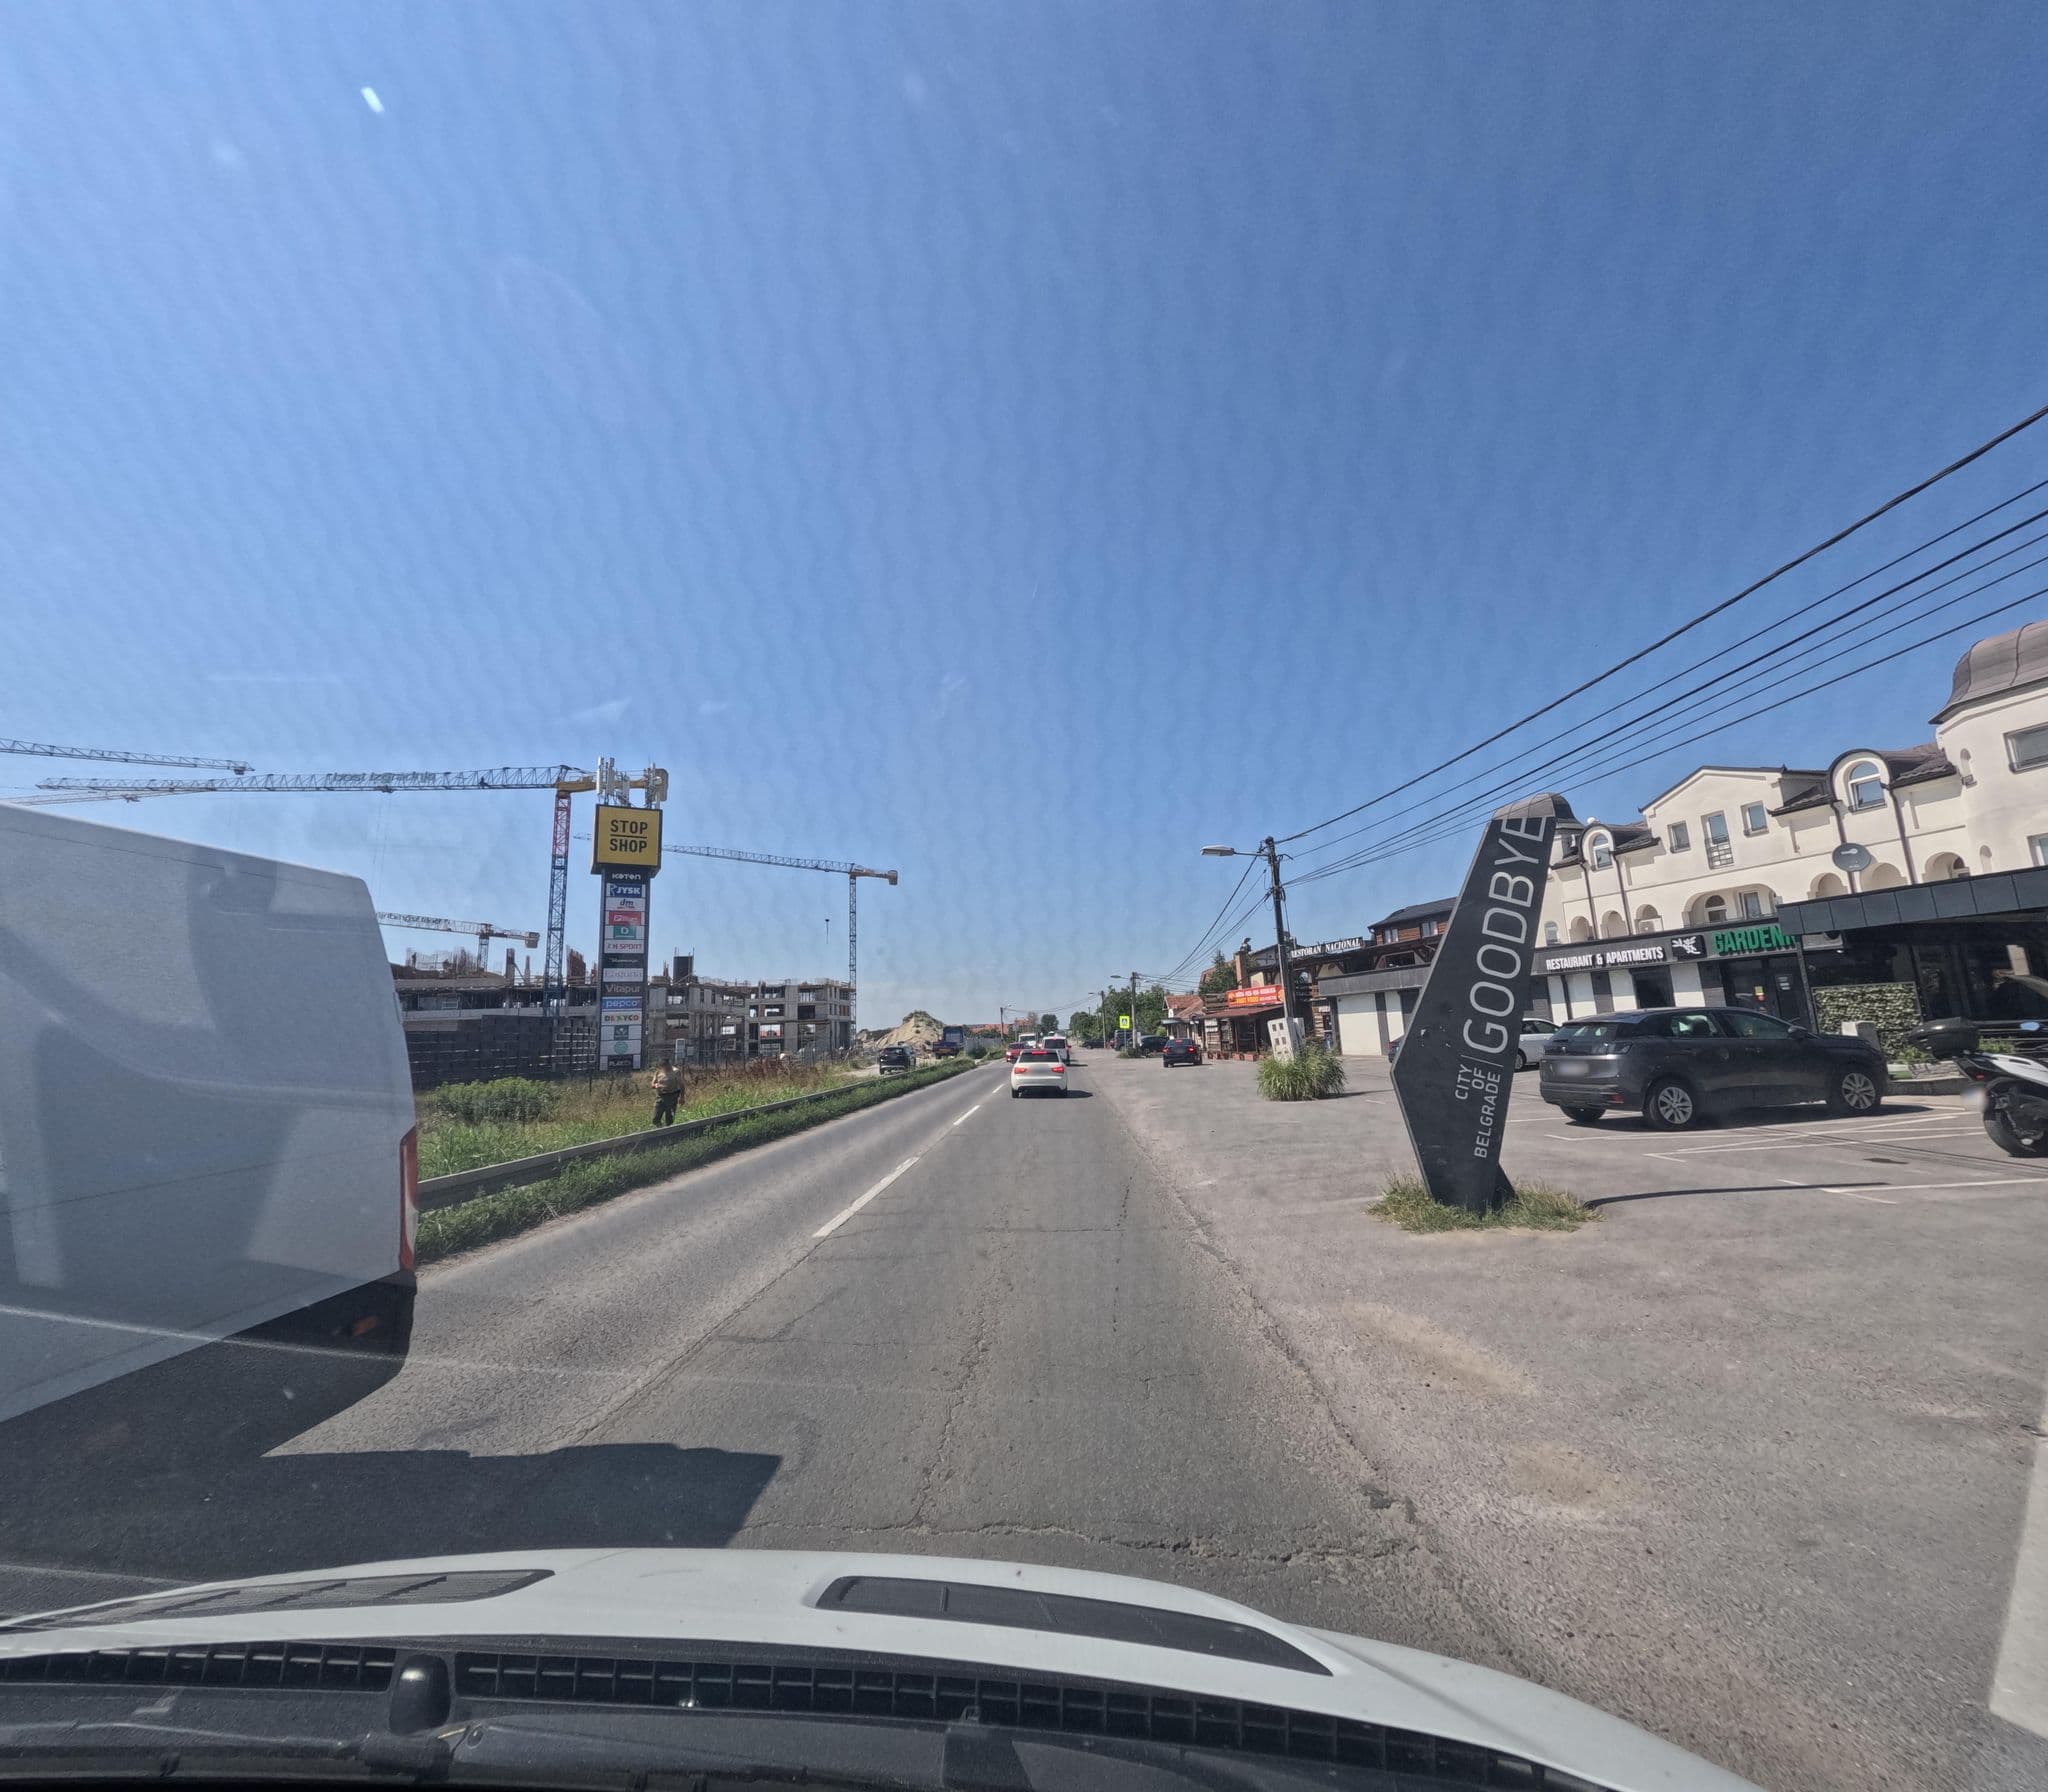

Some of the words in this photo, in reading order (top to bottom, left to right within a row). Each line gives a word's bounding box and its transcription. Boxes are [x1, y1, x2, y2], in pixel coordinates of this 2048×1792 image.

[610, 819, 648, 835] STOP
[609, 838, 647, 853] SHOP
[616, 887, 641, 895] JYSK
[1463, 816, 1547, 1054] GOODBYE
[1325, 938, 1361, 952] NACIONAL
[1545, 954, 1593, 970] RESTAURANT
[1595, 953, 1603, 965] &
[1606, 946, 1664, 964] APARTMENTS
[605, 984, 640, 994] Vitapur
[606, 1000, 638, 1008] pepco
[1456, 1063, 1473, 1100] CITY
[1471, 1067, 1487, 1090] OF
[1474, 1072, 1501, 1158] BELGRADE
